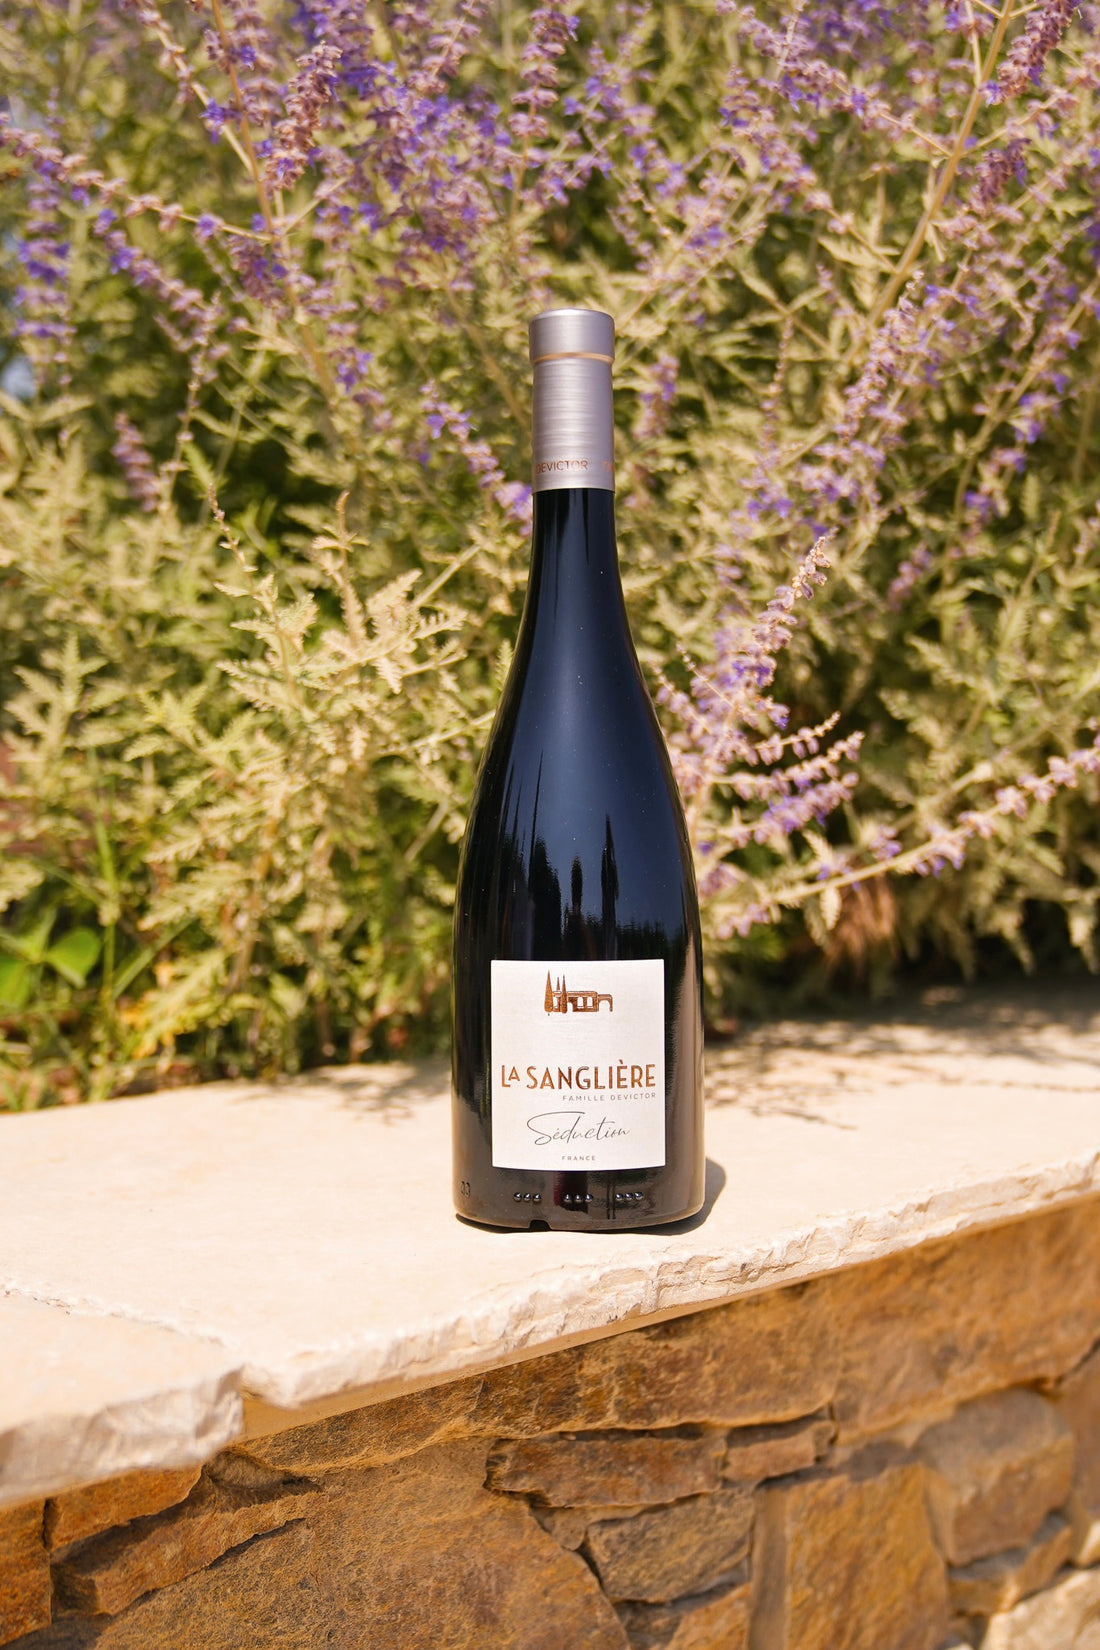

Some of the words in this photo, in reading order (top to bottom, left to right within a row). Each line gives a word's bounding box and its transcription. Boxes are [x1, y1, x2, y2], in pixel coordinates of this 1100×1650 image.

[536, 460, 589, 474] DEVICTOR
[526, 1060, 656, 1090] SANGLIÈRE
[610, 1092, 656, 1101] DEVICTOR
[527, 1111, 631, 1146] Séduction
